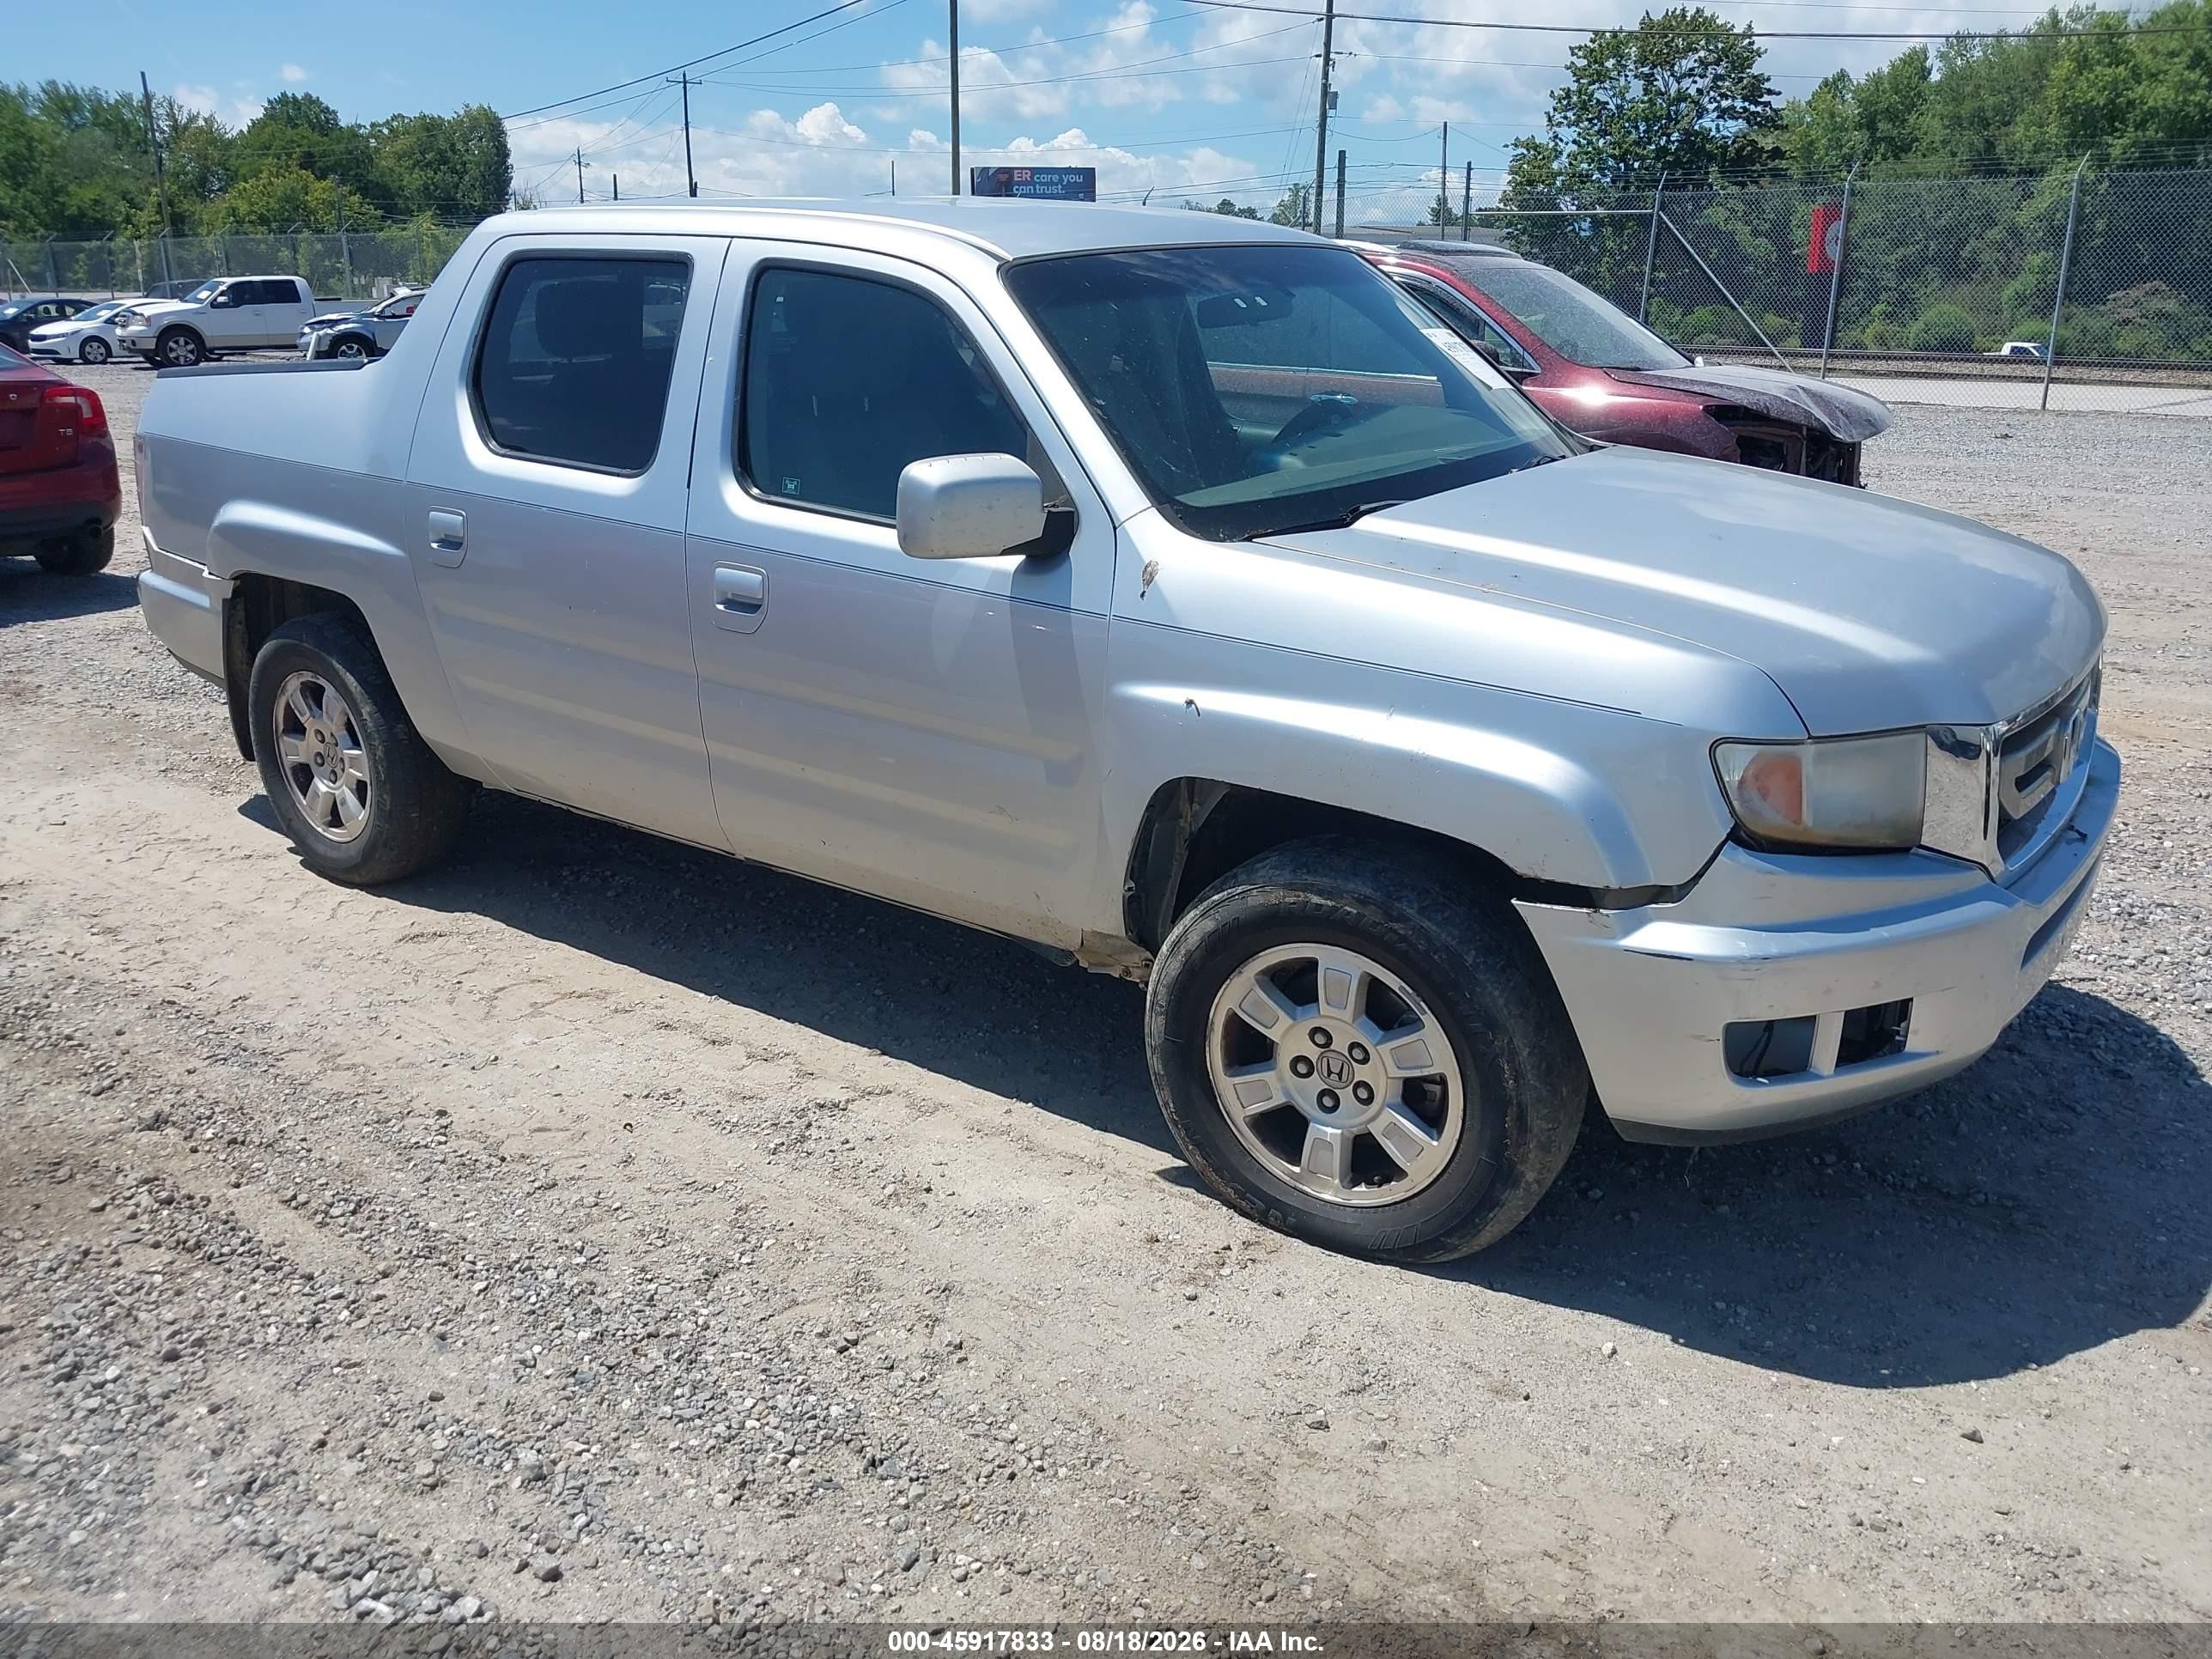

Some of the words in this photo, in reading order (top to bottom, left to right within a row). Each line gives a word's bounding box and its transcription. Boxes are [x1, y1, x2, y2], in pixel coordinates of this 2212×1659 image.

[1013, 169, 1031, 181] ER
[1034, 173, 1059, 182] care
[1061, 173, 1084, 185] you
[1012, 185, 1034, 194] can
[1036, 183, 1066, 194] trust.
